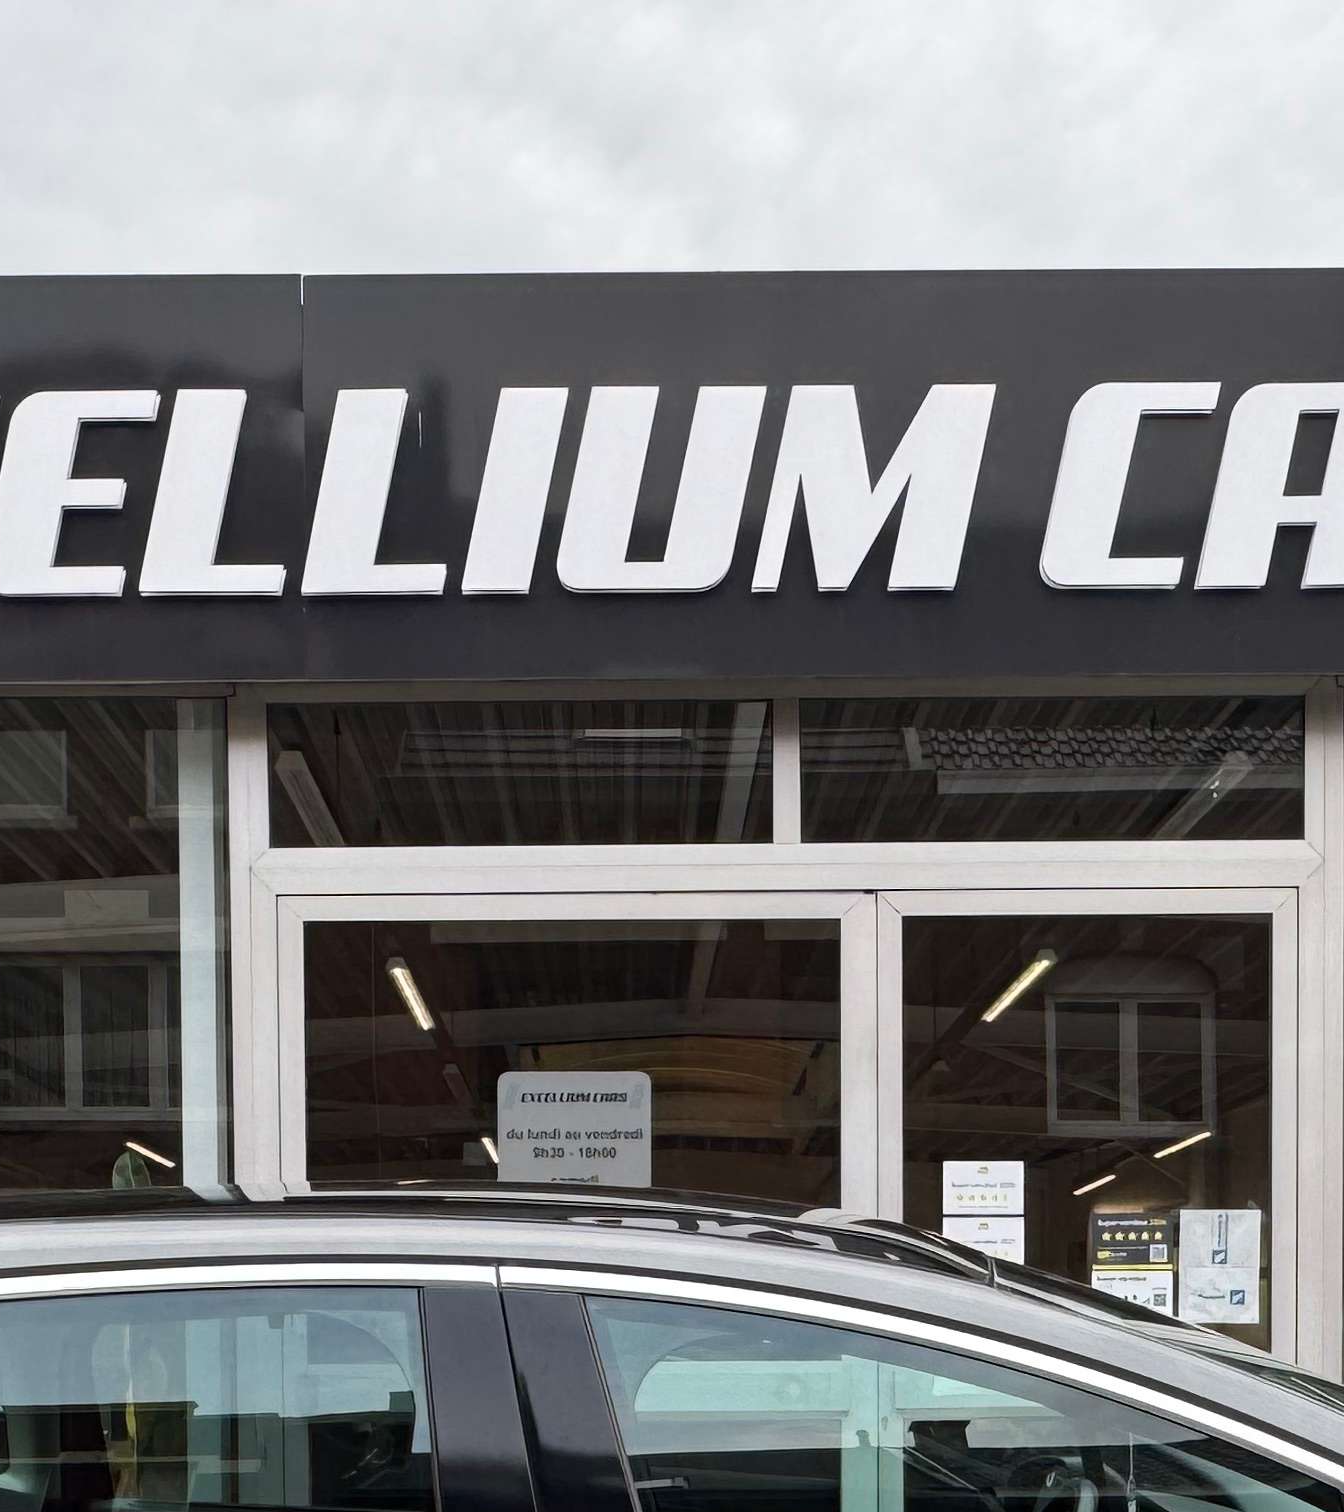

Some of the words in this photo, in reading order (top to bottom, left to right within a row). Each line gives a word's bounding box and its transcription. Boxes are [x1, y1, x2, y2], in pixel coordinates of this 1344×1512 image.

[506, 1128, 524, 1140] du
[527, 1128, 561, 1140] lundi
[585, 1128, 644, 1141] vendredi
